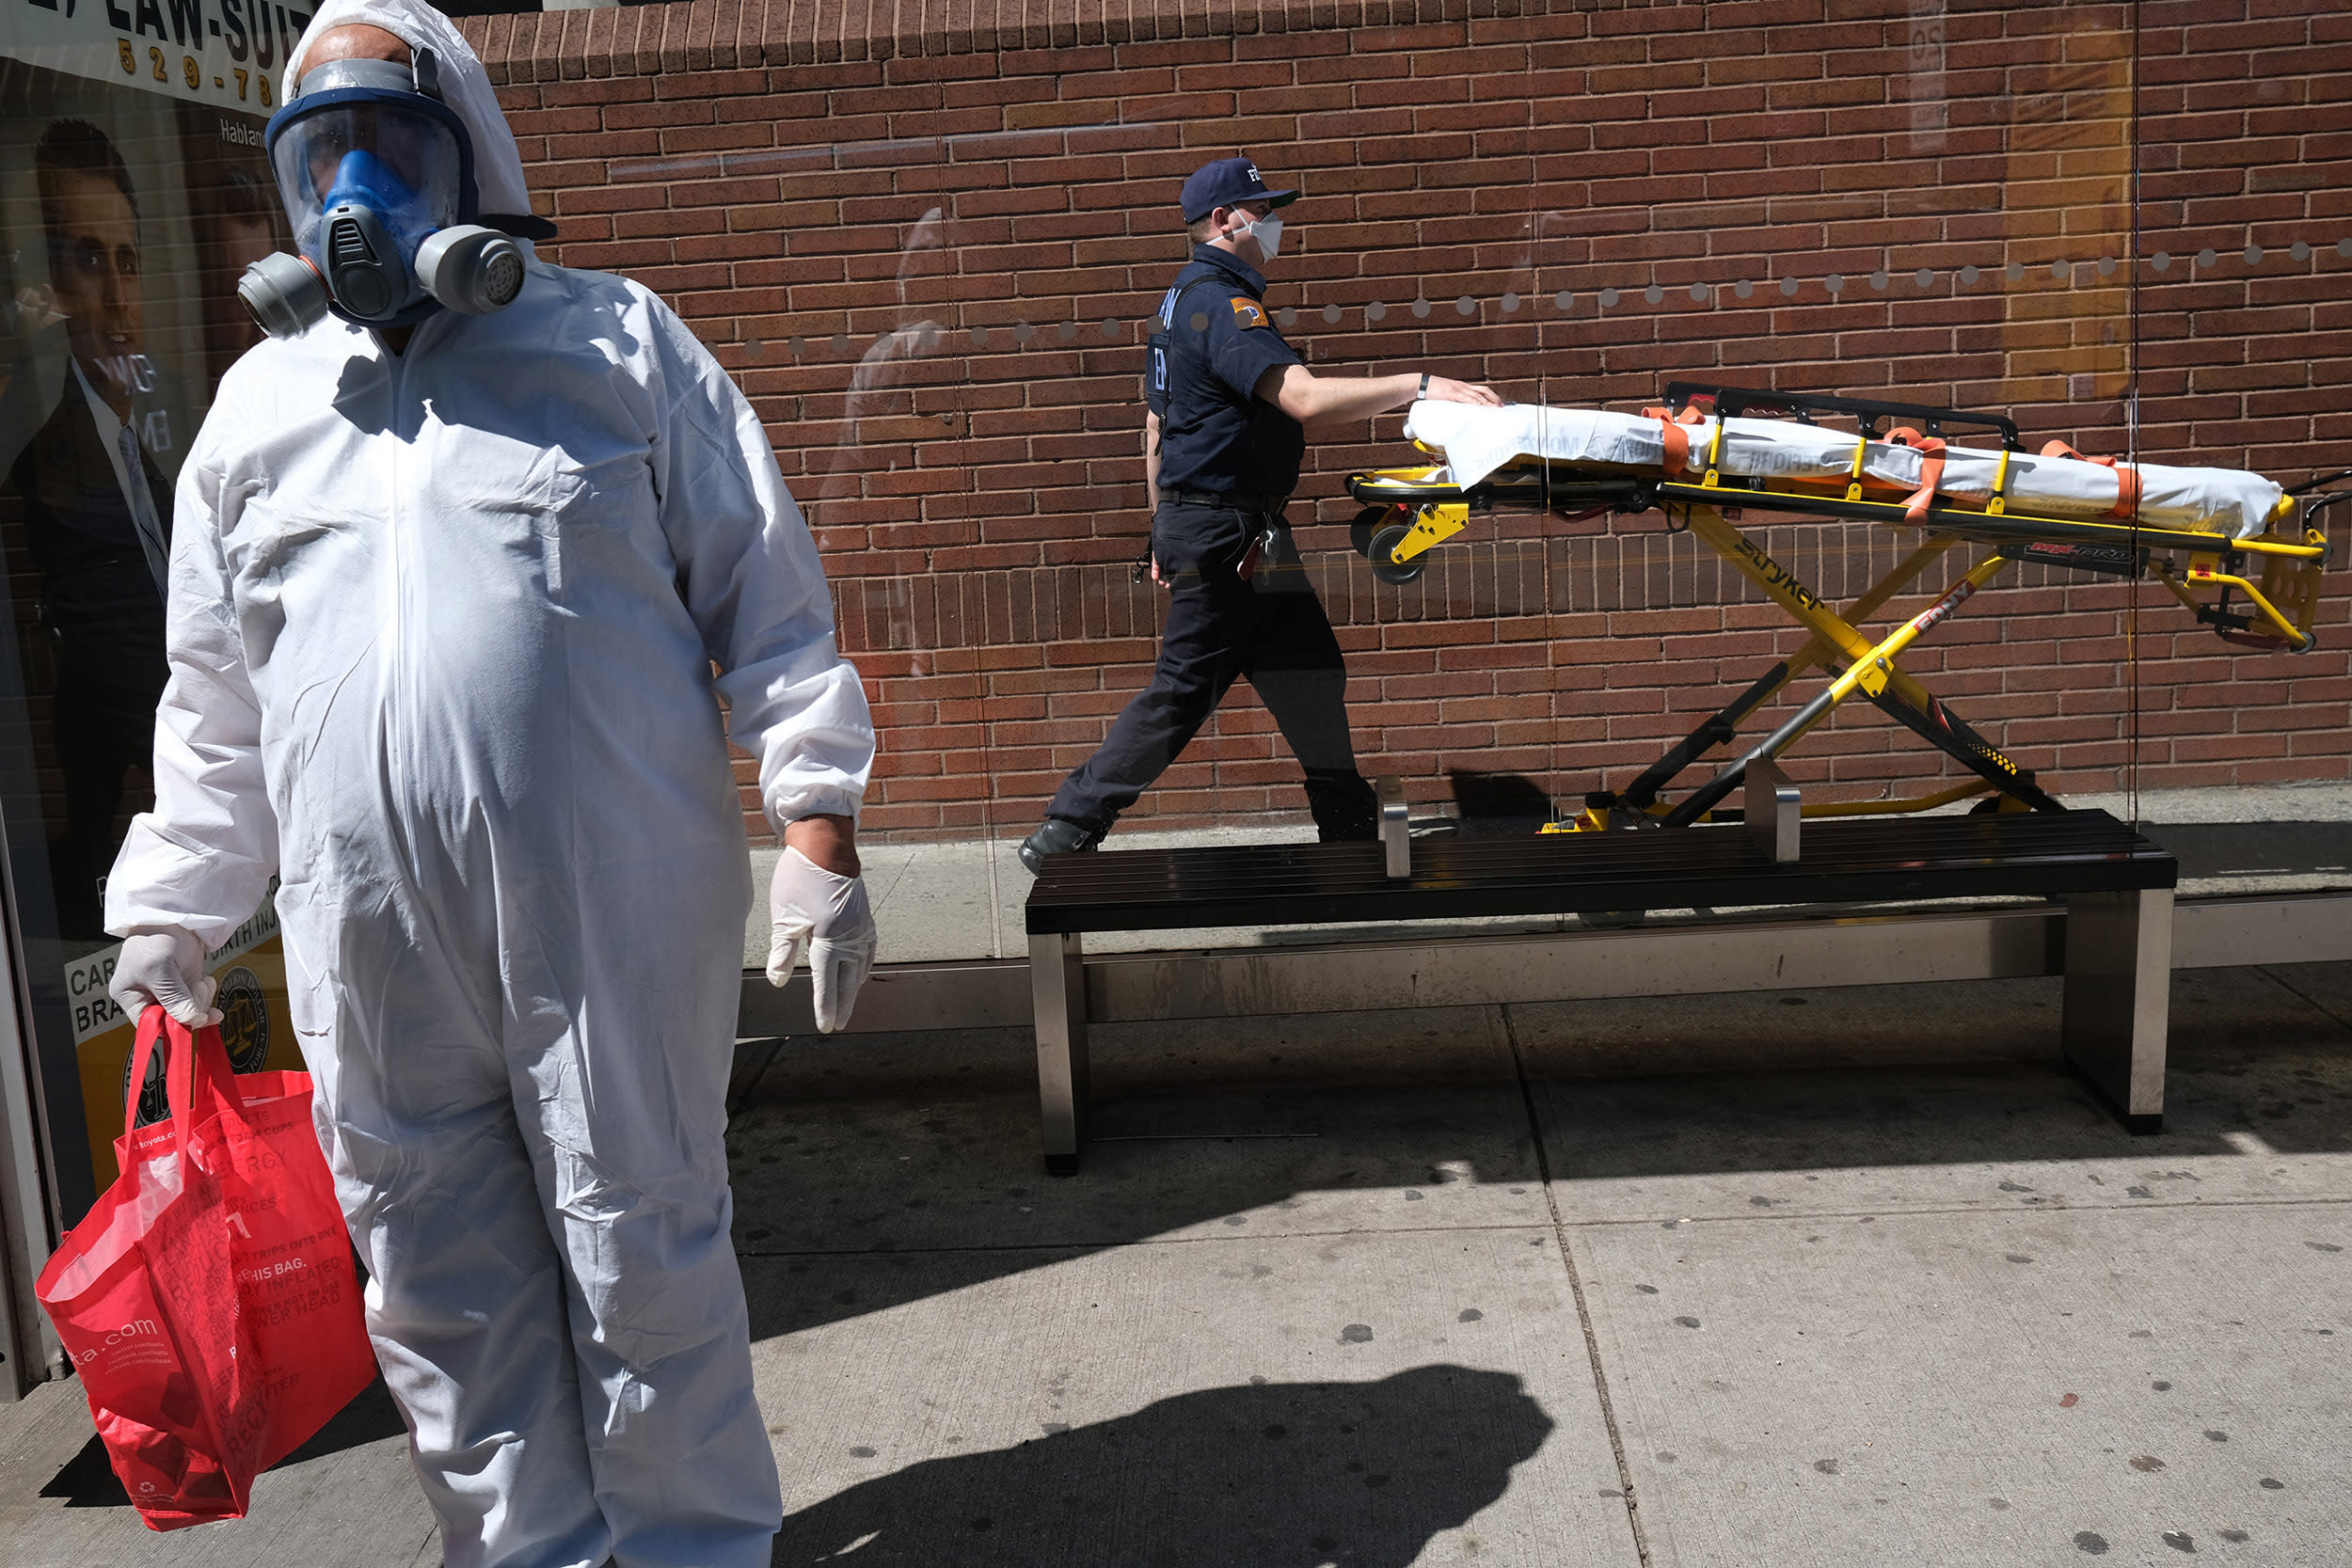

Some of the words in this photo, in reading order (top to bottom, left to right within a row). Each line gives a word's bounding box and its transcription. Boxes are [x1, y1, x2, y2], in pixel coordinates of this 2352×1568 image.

[1734, 538, 1825, 611] Stryker
[1916, 583, 1975, 634] FDNY
[256, 905, 279, 936] INJ
[275, 1258, 308, 1275] BAG.
